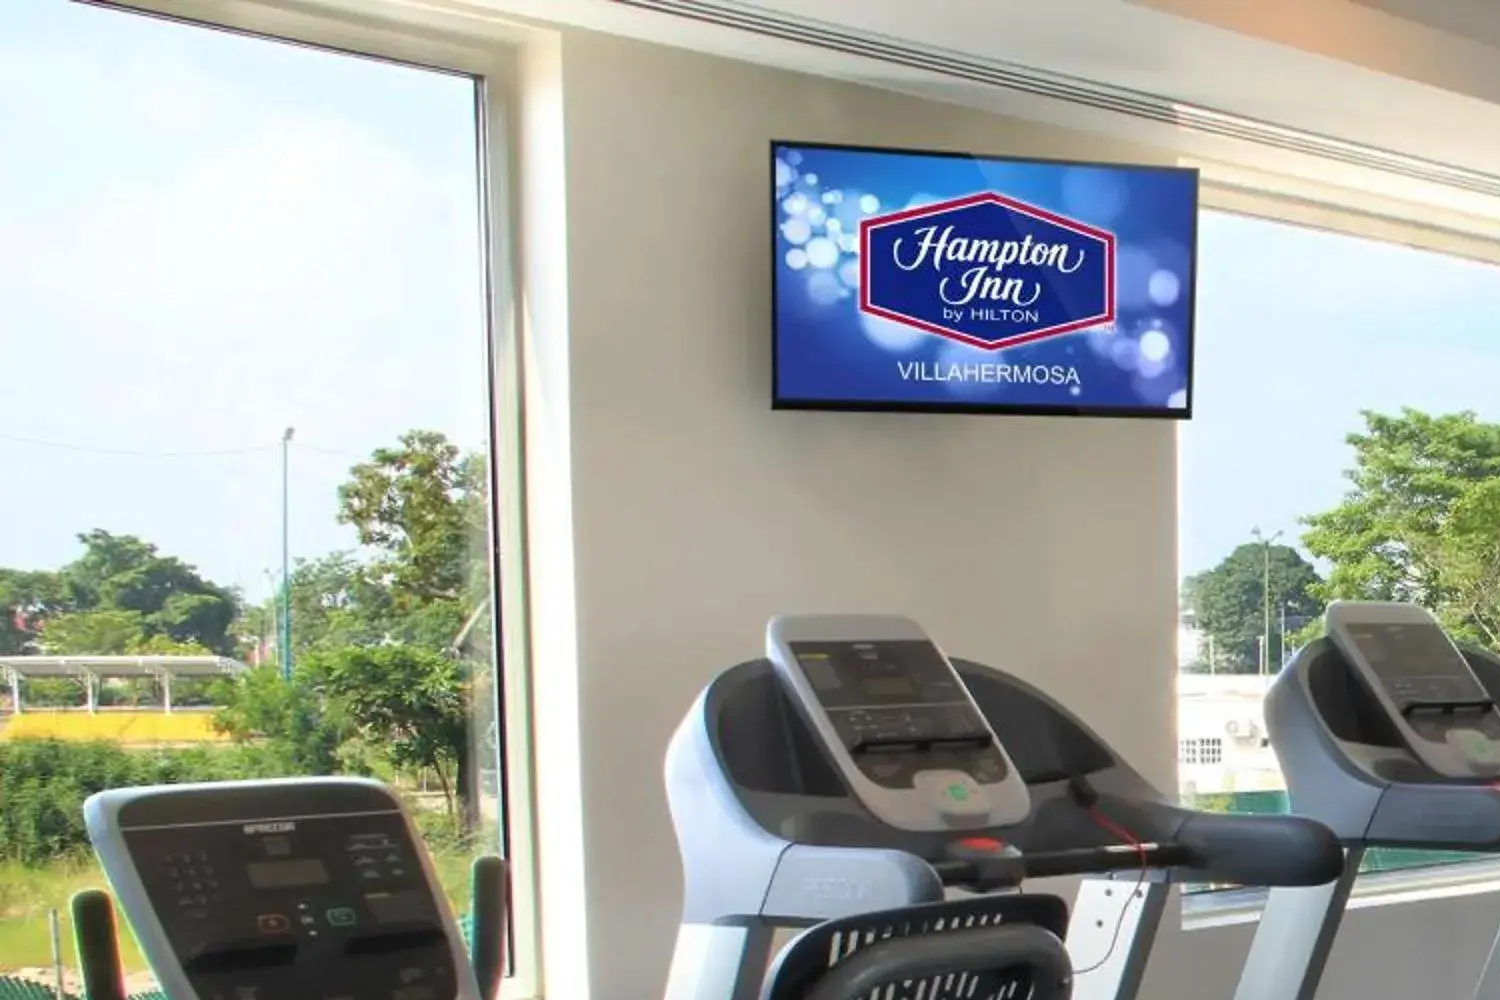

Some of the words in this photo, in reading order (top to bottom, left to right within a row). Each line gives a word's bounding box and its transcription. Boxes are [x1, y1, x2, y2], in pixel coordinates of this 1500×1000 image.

[893, 225, 1085, 273] Hampton
[939, 266, 1041, 306] Inn
[943, 307, 964, 322] by
[971, 307, 1039, 323] HILTON
[897, 360, 1081, 385] VILLAHERMOSA
